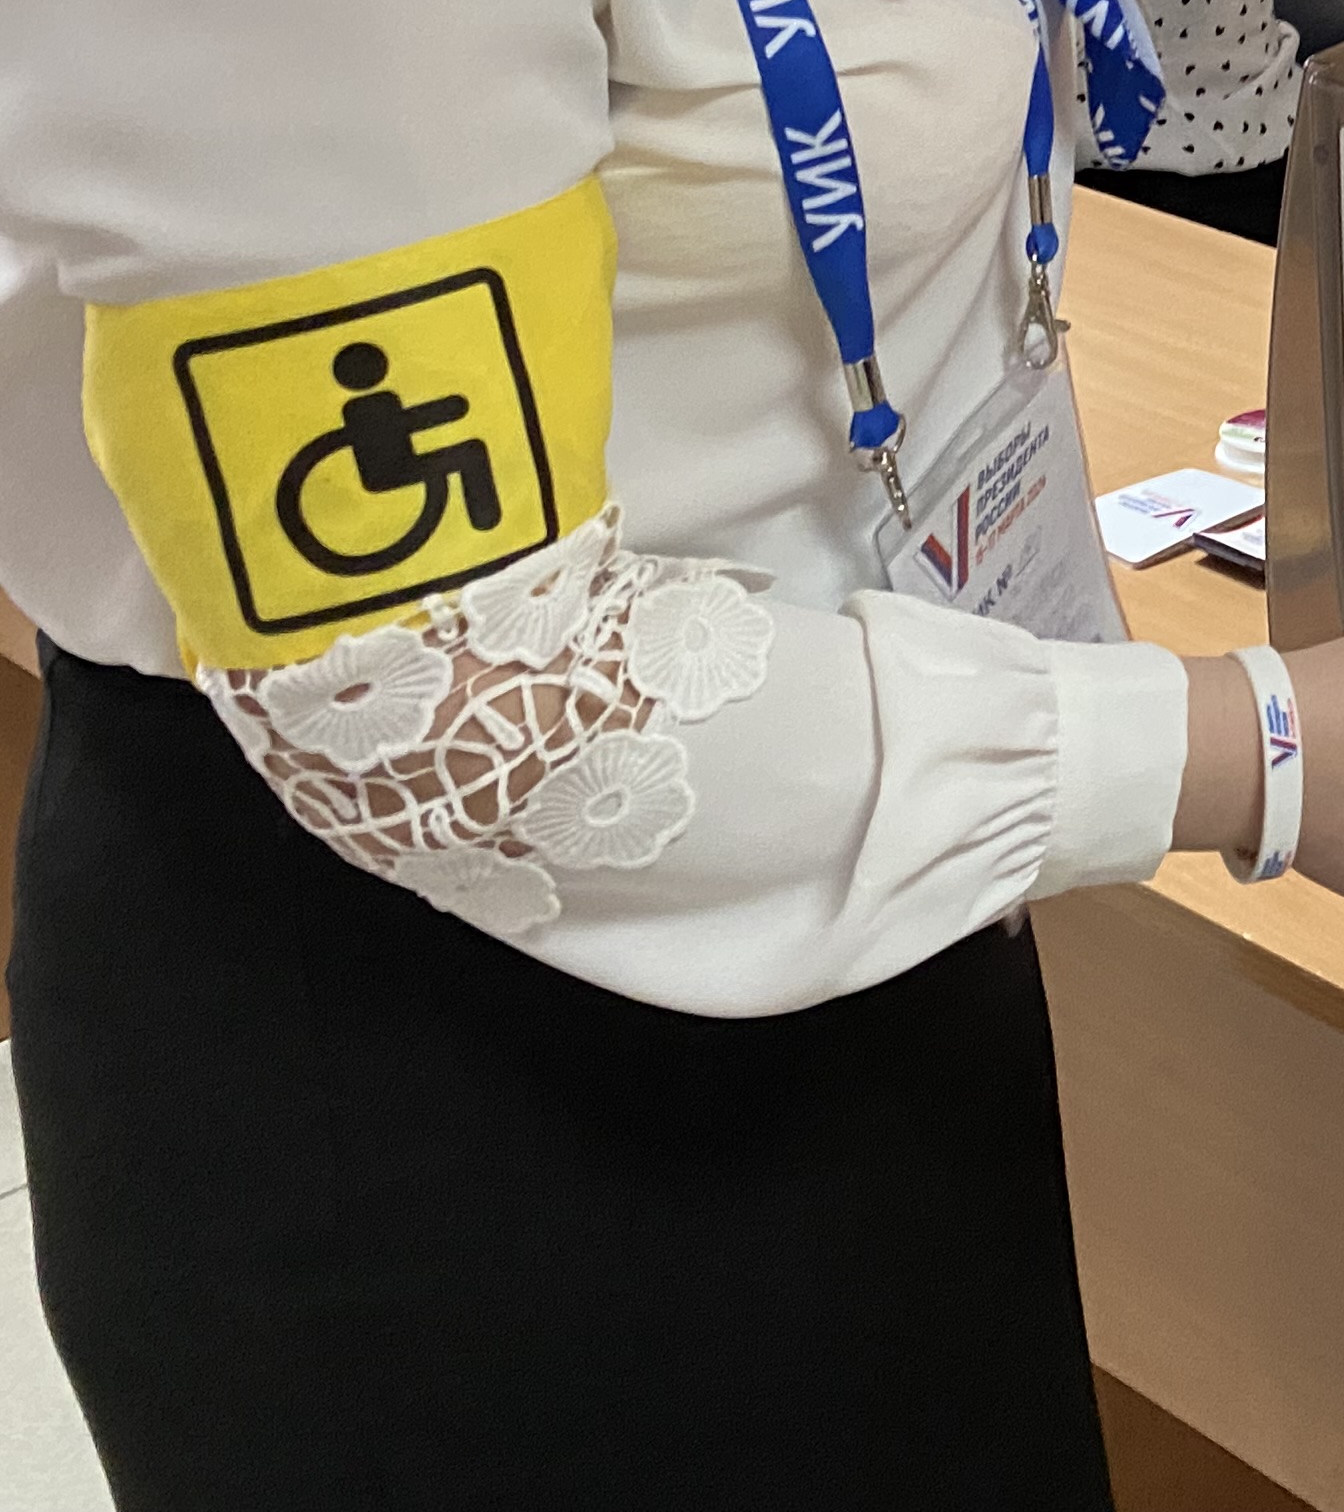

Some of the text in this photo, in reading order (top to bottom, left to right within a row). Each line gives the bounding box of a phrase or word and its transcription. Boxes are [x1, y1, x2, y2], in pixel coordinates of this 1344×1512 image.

[784, 109, 864, 252] УИК
[976, 425, 1050, 517] ПРЕЗИДЕНТА
[977, 422, 1032, 490] ВЫБОРЫ
[975, 479, 1021, 545] РОССИИ
